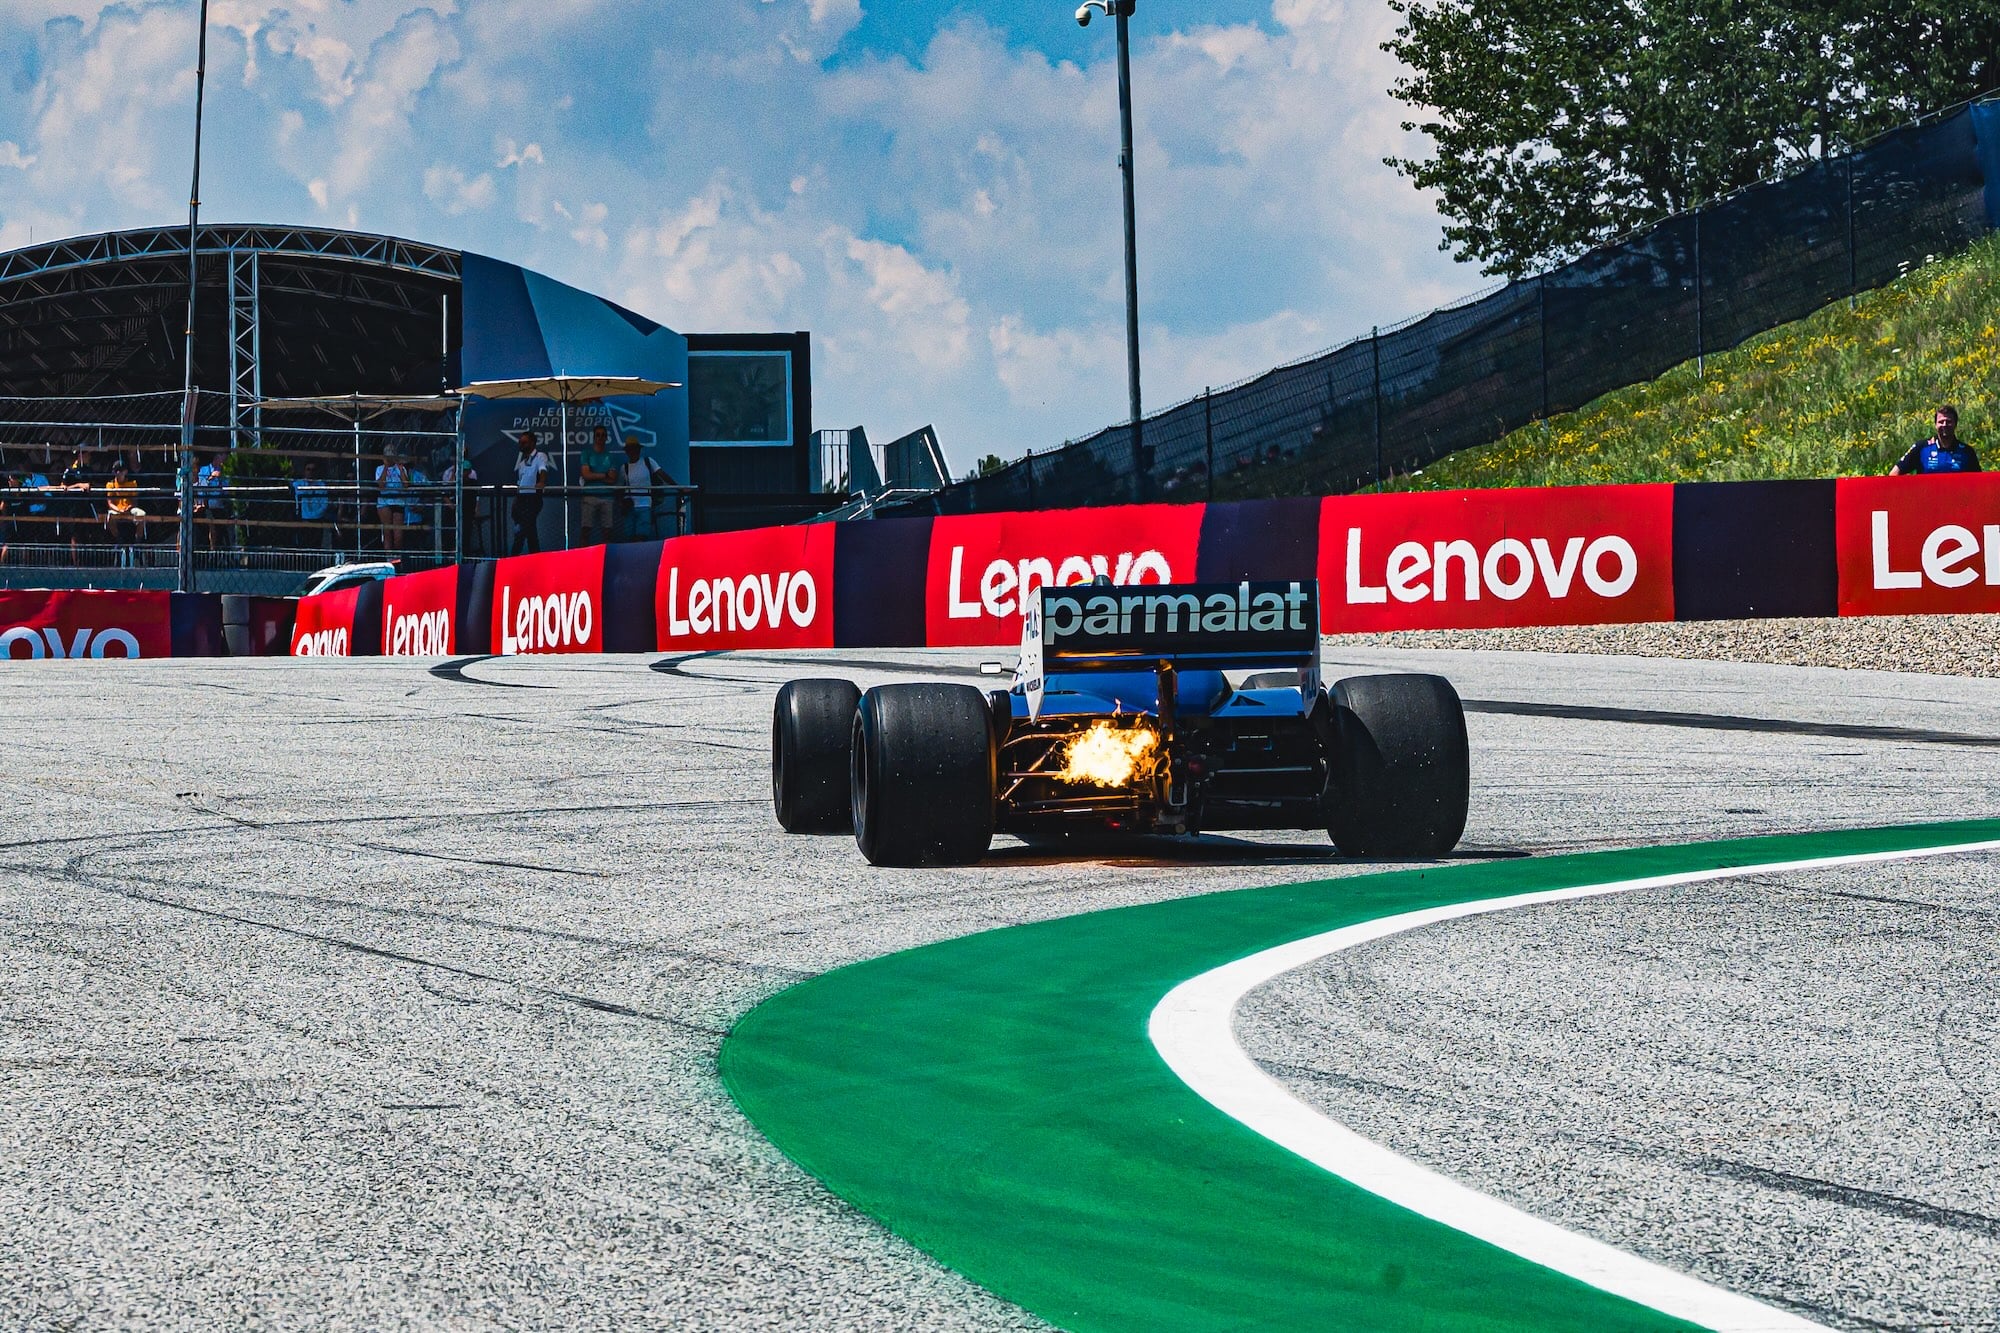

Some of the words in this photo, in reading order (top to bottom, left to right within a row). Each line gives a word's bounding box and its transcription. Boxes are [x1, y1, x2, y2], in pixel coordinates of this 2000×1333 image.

[1346, 527, 1638, 604] Lenovo
[502, 586, 592, 655] Lenovo
[669, 567, 817, 637] Lenovo
[1044, 581, 1308, 646] parmalat
